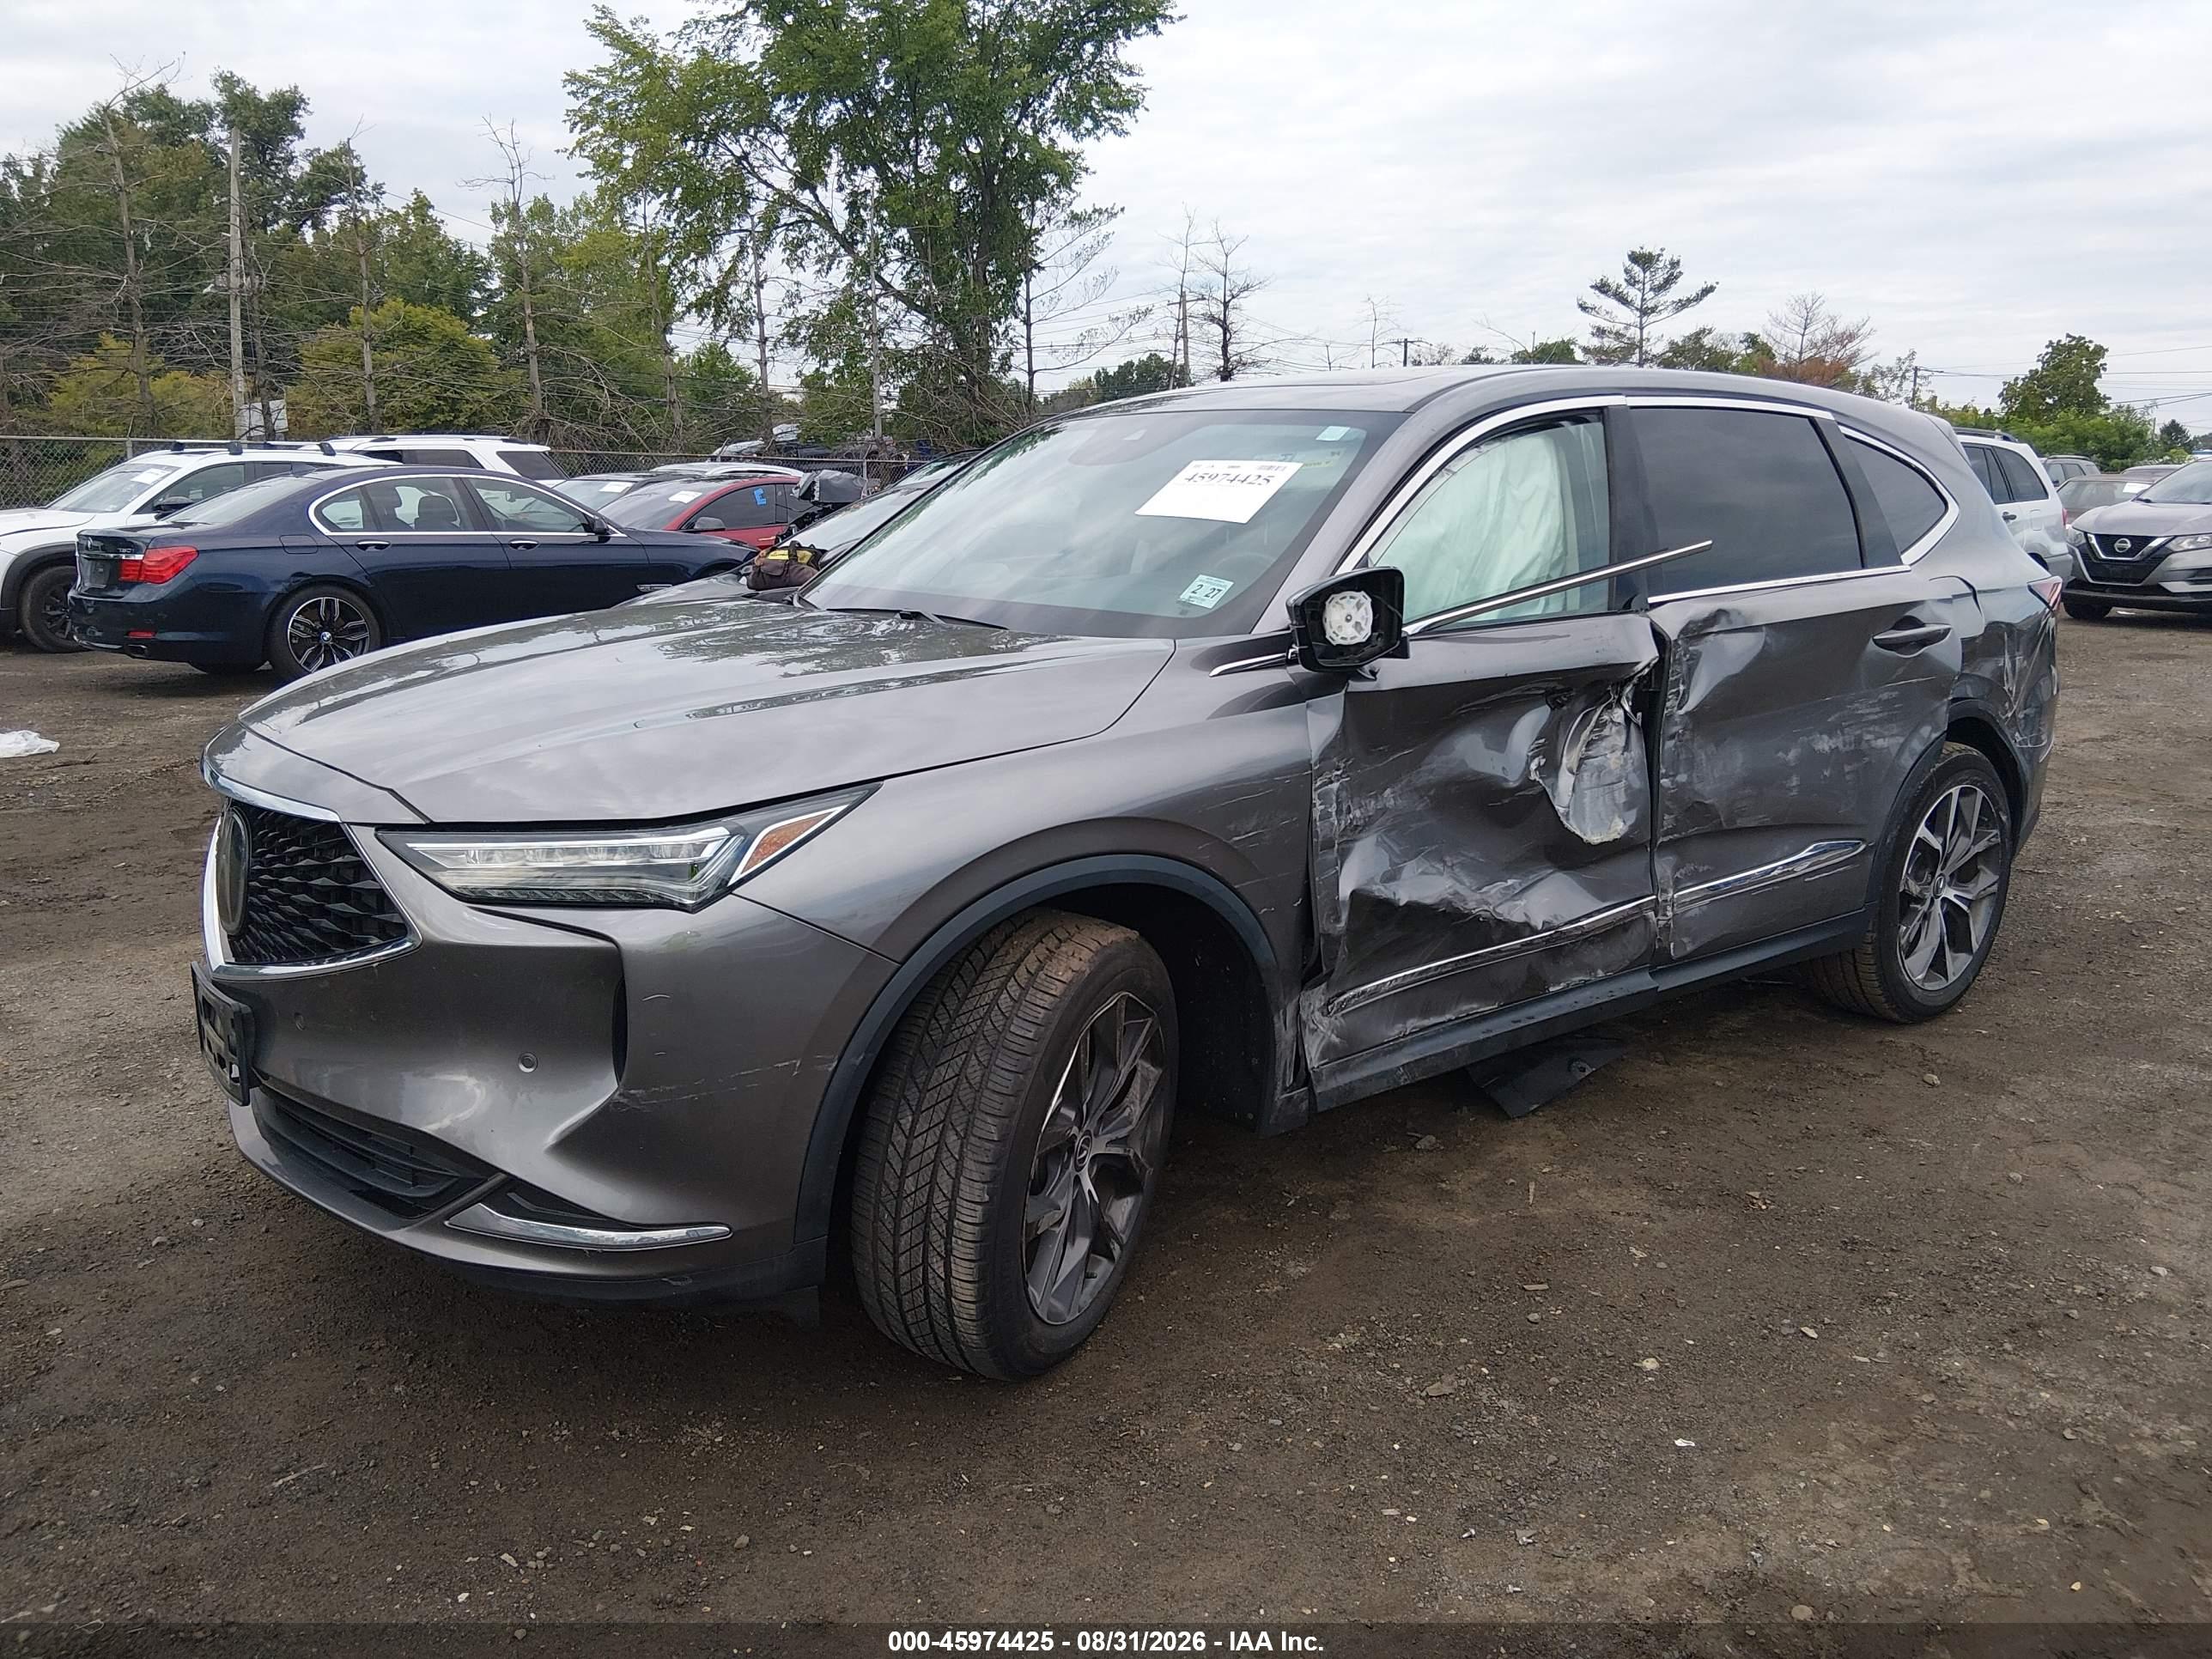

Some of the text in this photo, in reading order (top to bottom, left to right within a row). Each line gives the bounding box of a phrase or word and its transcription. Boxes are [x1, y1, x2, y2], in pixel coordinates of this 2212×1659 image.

[1184, 471, 1276, 486] 45974425
[1190, 584, 1204, 595] 2
[1204, 587, 1223, 599] 27
